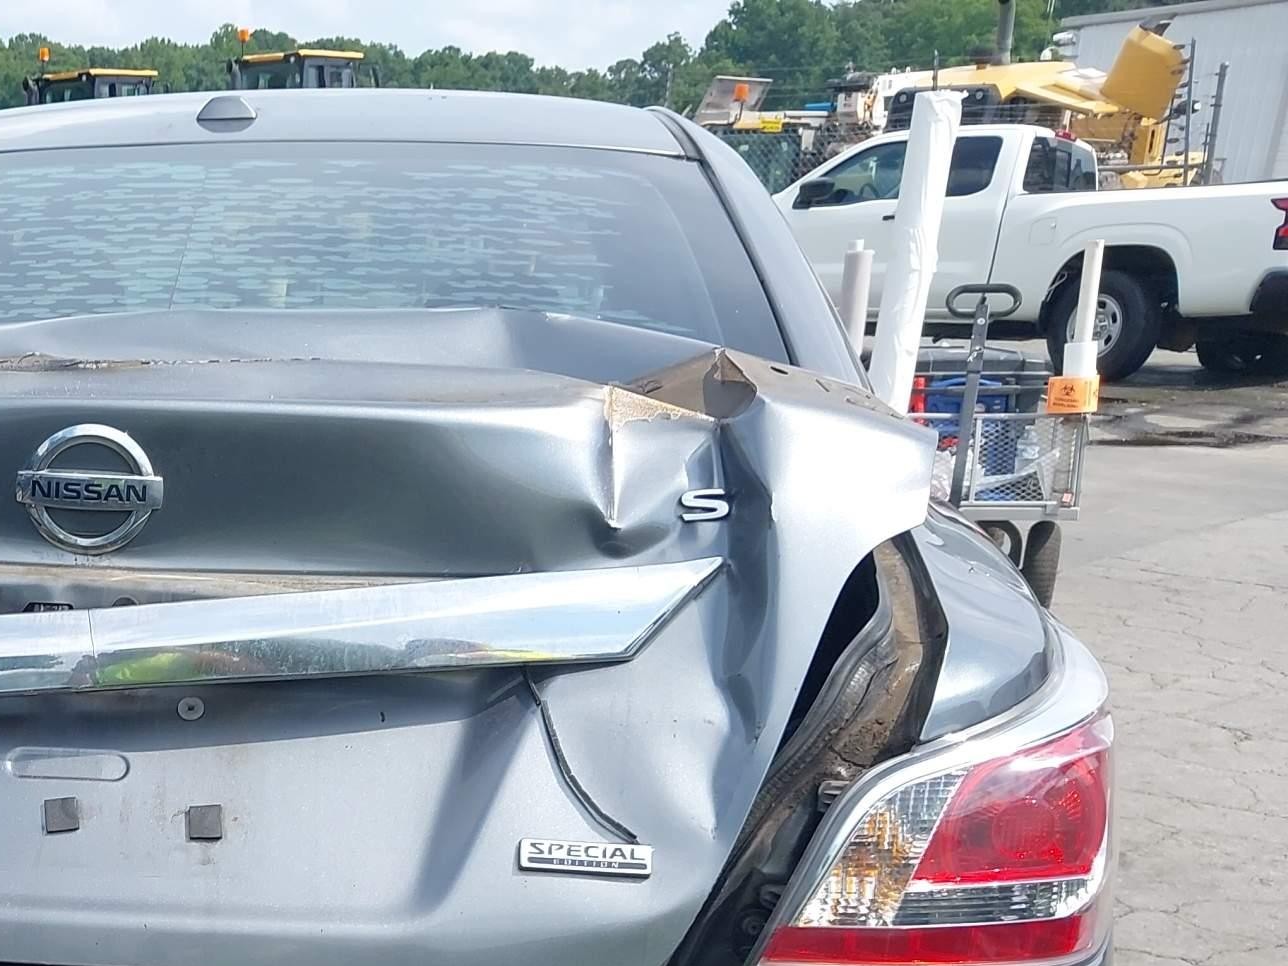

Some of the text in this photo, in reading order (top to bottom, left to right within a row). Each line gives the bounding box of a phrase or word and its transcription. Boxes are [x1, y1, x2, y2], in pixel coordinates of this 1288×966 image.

[31, 480, 147, 502] NISSAN
[680, 487, 730, 522] S
[527, 842, 646, 861] SPECIAL
[552, 857, 619, 869] EDITION
